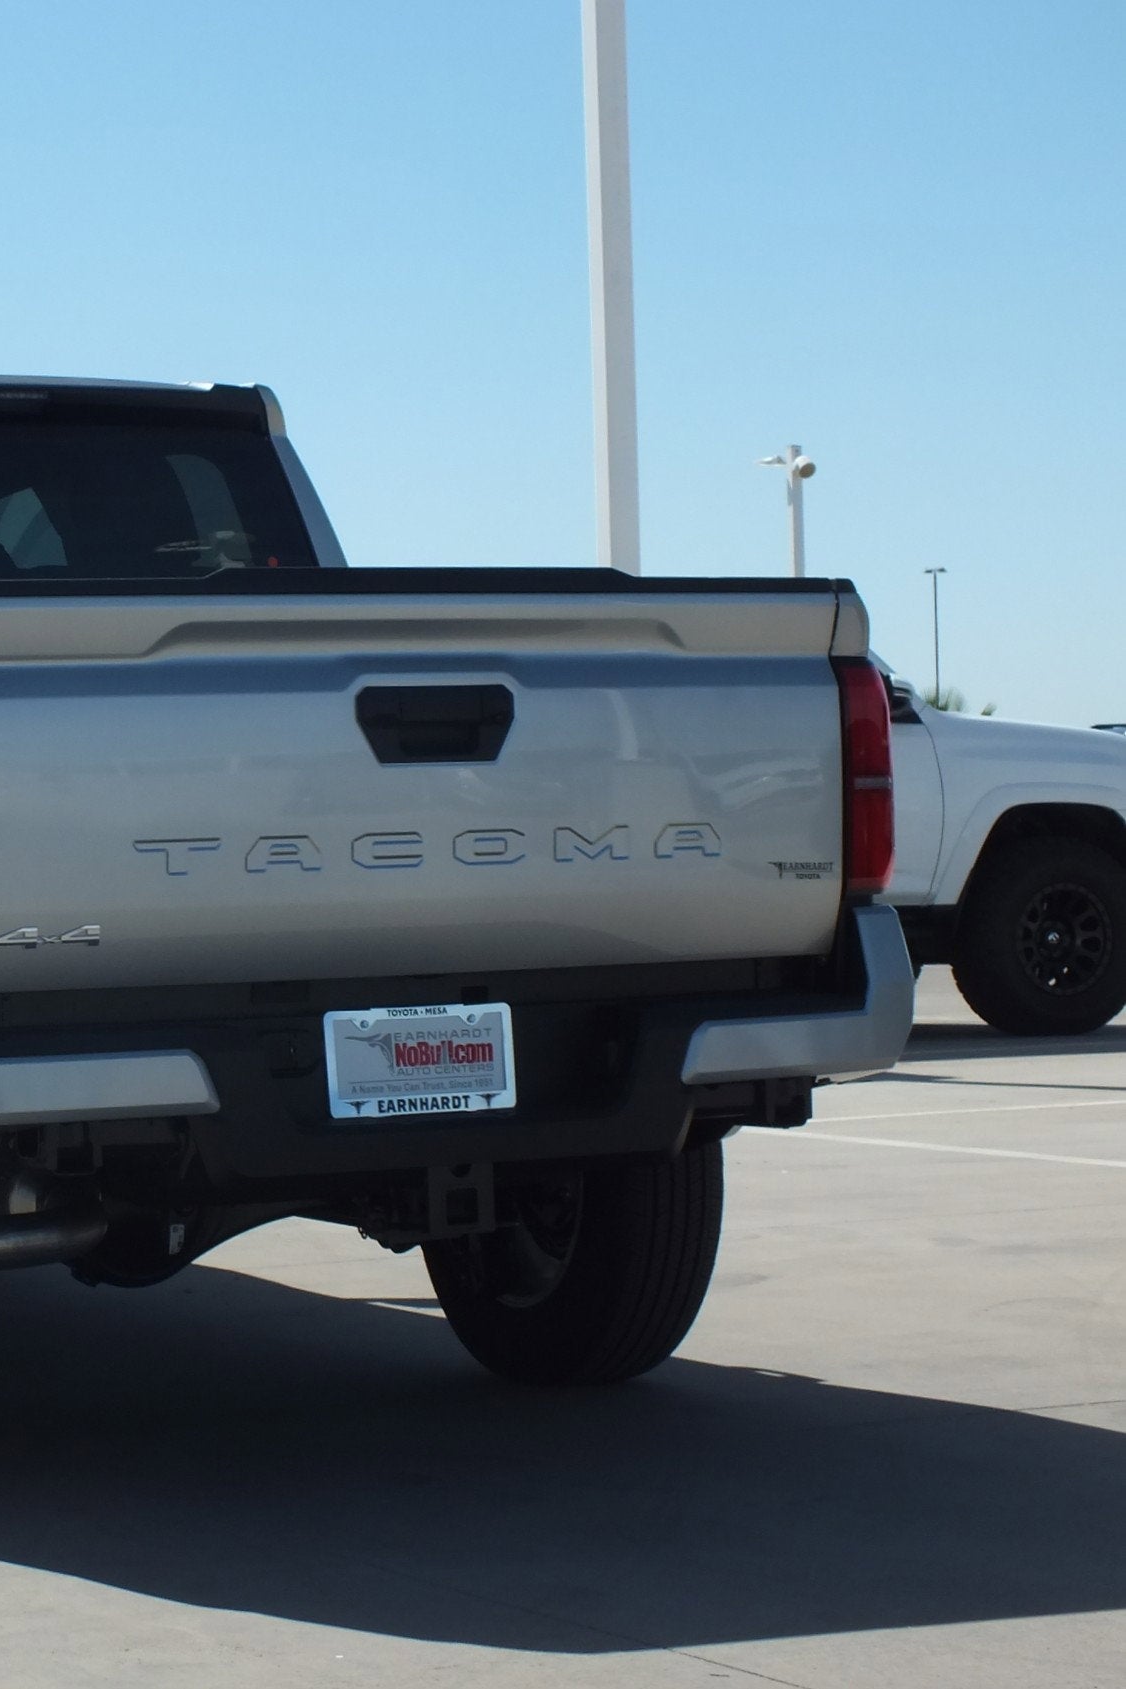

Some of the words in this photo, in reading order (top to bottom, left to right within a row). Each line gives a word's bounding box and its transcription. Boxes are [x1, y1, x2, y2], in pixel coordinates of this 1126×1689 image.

[132, 822, 721, 876] TACOMA
[387, 1008, 419, 1018] TOYOTA
[425, 1006, 448, 1016] MESA
[393, 1027, 493, 1042] EARNHARDT
[397, 1065, 432, 1076] AUTO
[434, 1063, 495, 1075] CENTERS
[377, 1095, 471, 1114] EARNHARDT
